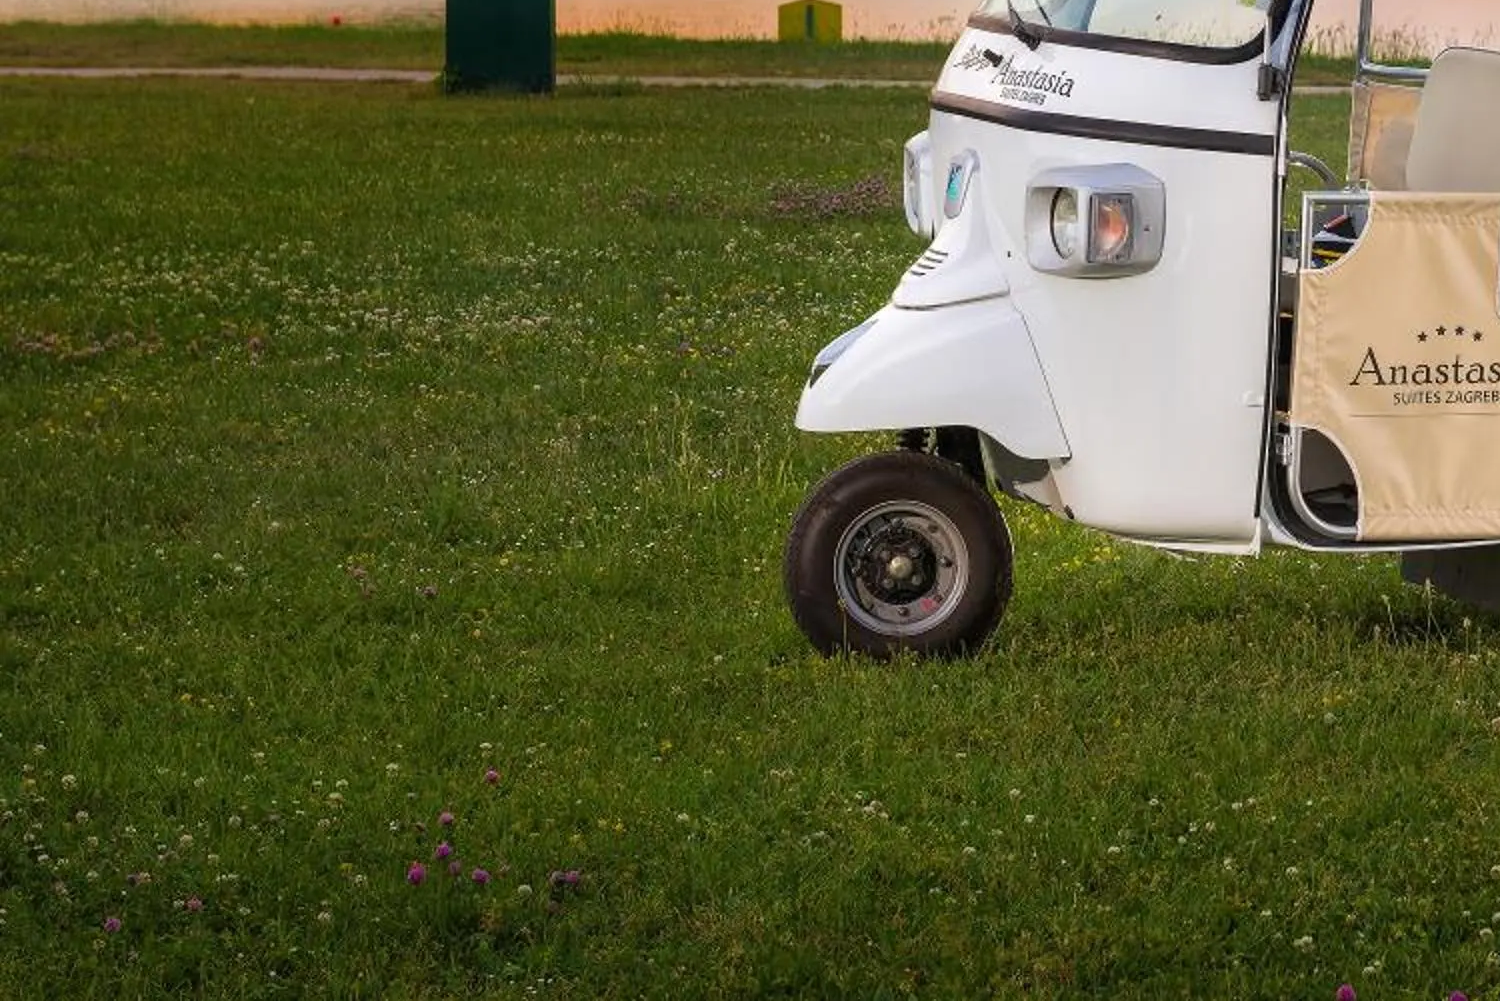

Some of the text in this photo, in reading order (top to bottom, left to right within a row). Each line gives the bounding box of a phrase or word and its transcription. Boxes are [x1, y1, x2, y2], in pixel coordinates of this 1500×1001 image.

[991, 54, 1076, 98] Anastasia
[1393, 390, 1500, 406] SUITES ZAGREB
